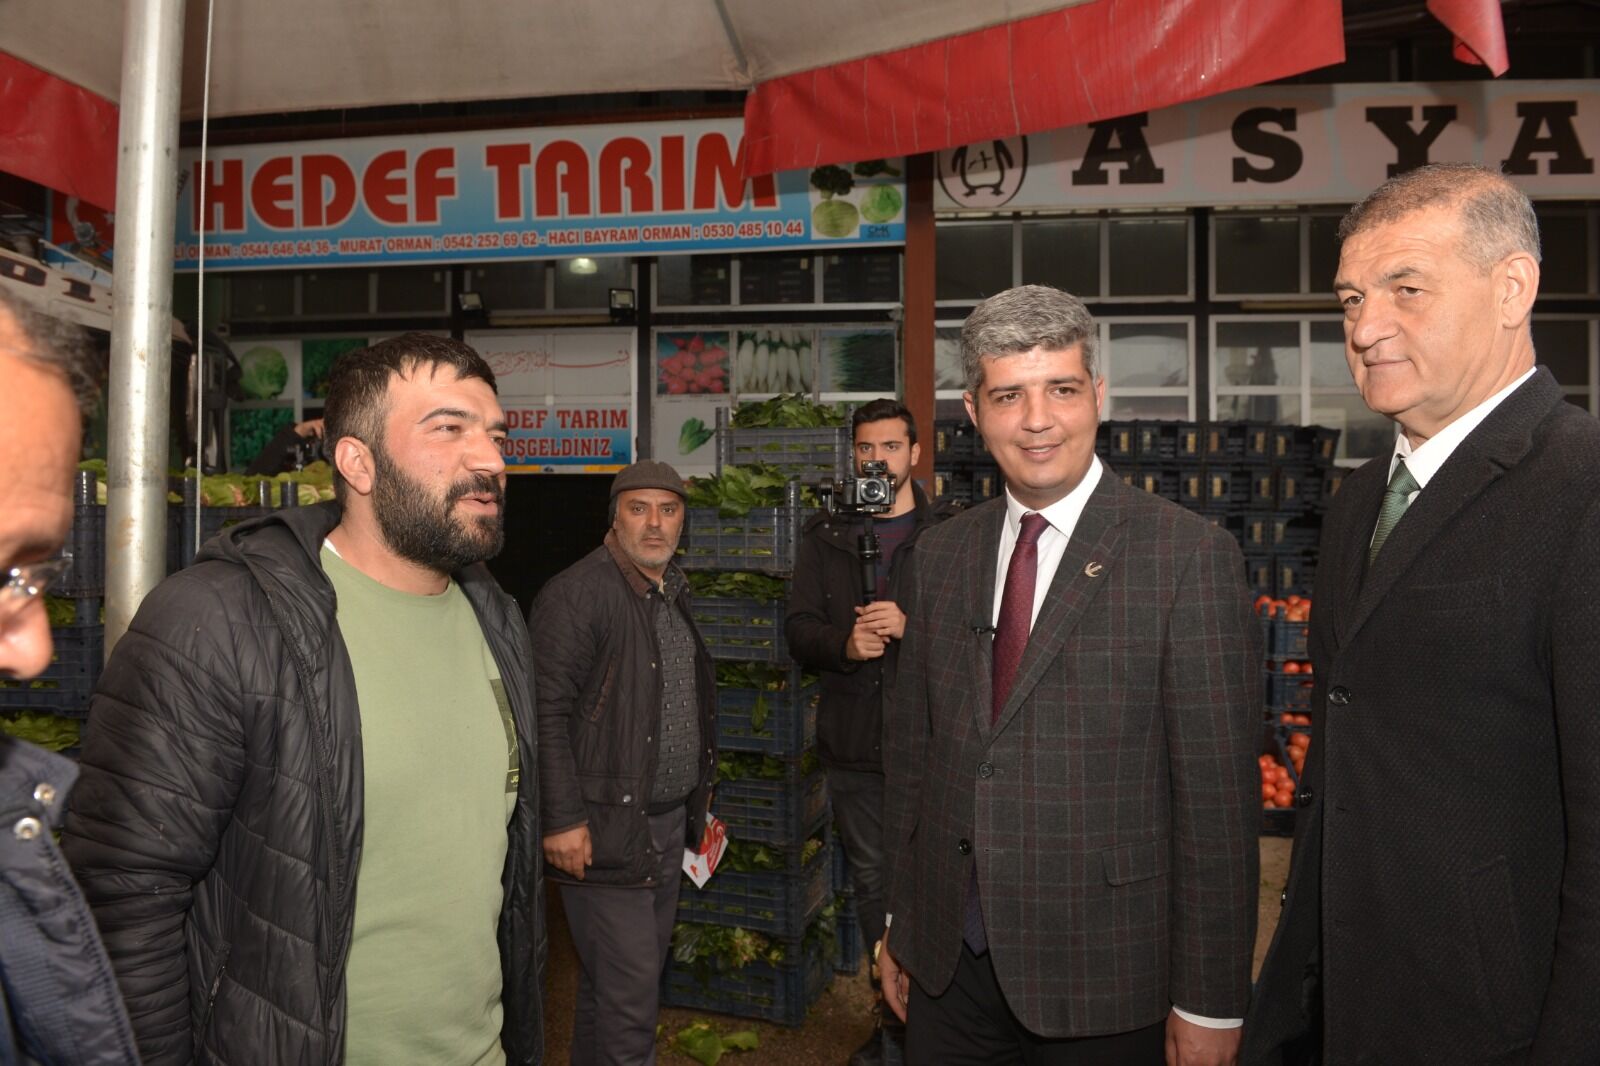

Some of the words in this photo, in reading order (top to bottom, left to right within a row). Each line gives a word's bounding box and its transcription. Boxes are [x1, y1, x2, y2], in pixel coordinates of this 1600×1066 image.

[1071, 101, 1594, 186] ASYA
[193, 147, 456, 231] HEDEF
[486, 132, 777, 218] TARIM
[241, 243, 269, 257] 0544
[272, 241, 294, 256] 646
[297, 240, 312, 255] 64
[340, 239, 382, 253] MURAT
[387, 237, 432, 251] ORMAN
[443, 235, 473, 249] 0542
[476, 234, 499, 248] 252
[503, 233, 518, 246] 69
[522, 232, 537, 246] 62
[548, 231, 579, 244] HACI
[584, 228, 638, 243] BAYRAM
[643, 226, 690, 240] ORMAN
[703, 224, 734, 238] 0530
[738, 222, 762, 236] 485
[766, 221, 782, 235] 10
[786, 221, 802, 234] 44
[505, 410, 548, 428] DEF
[556, 409, 628, 428] TARIM
[500, 432, 610, 459] OŞGELDİNİZ
